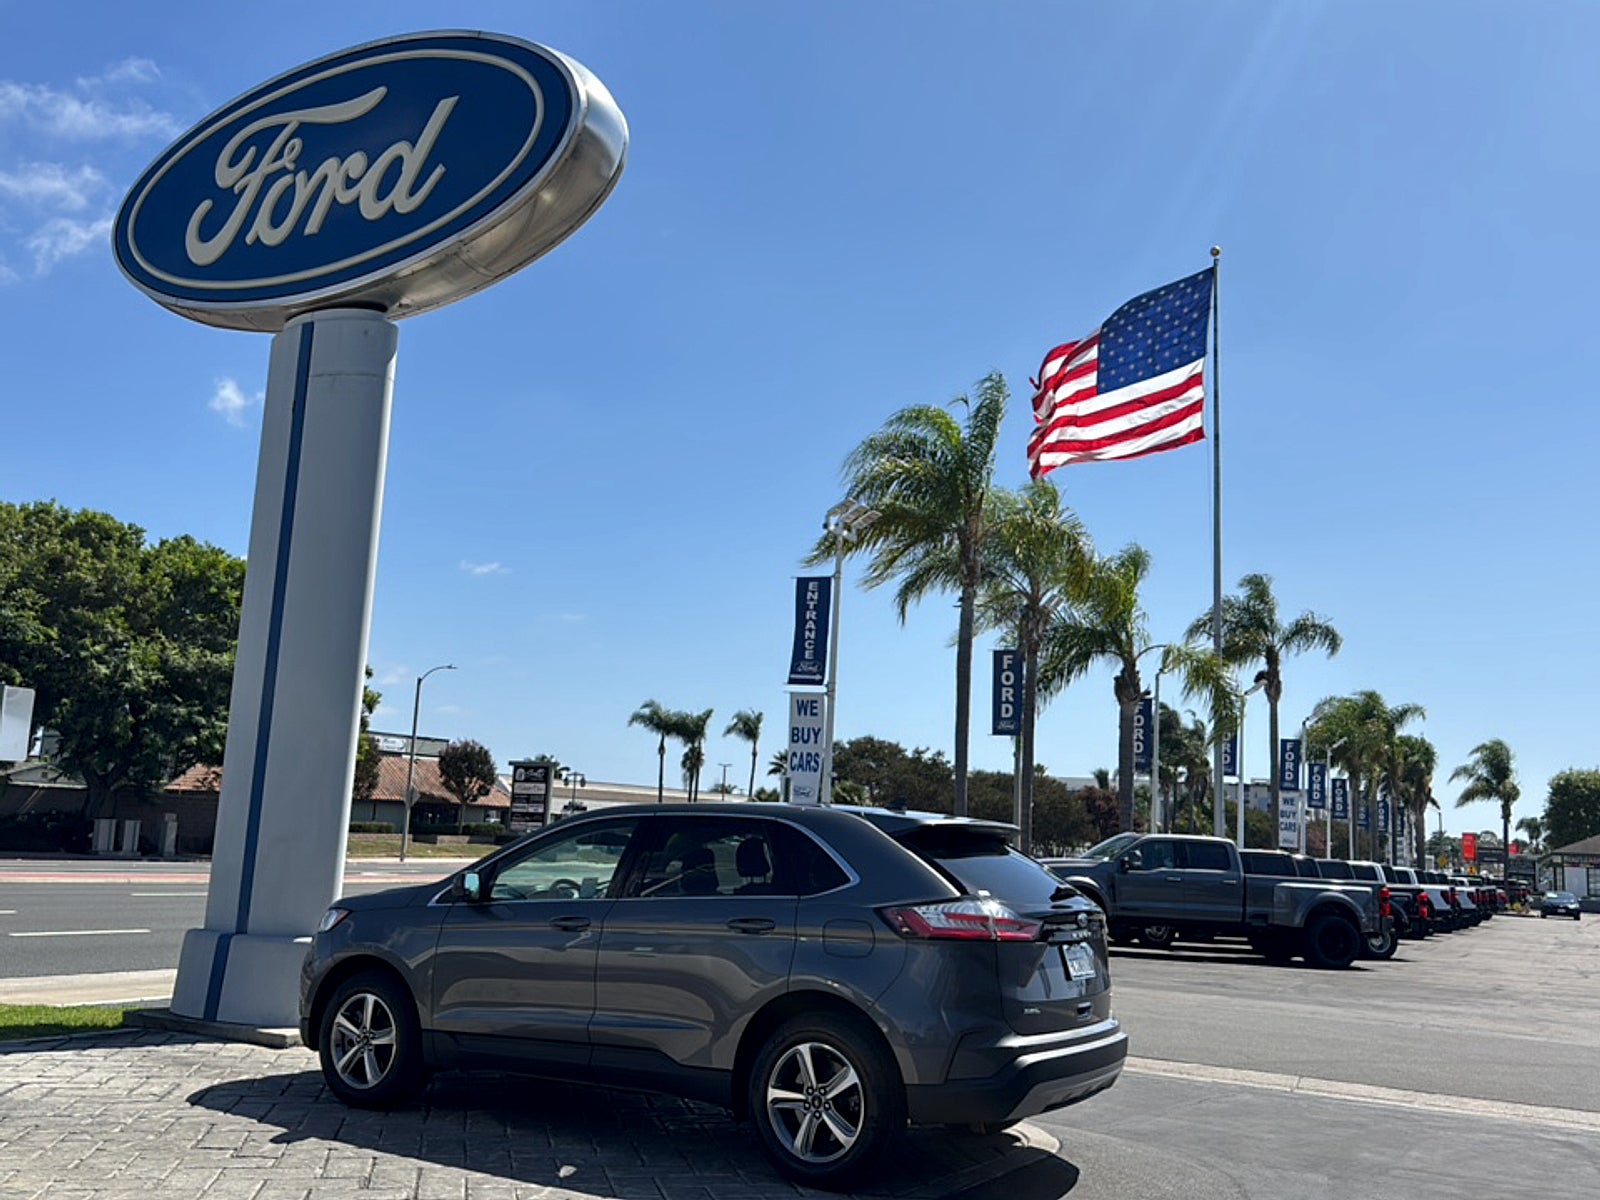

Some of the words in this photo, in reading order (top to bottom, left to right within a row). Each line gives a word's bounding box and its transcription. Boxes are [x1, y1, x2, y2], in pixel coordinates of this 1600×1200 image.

[185, 85, 459, 266] Ford
[804, 581, 819, 660] ENTRANCE
[1001, 654, 1015, 718] FORD
[796, 698, 818, 717] WE
[791, 726, 821, 745] BUY
[790, 751, 820, 773] CARS
[1284, 741, 1295, 781] FORD
[1312, 765, 1321, 800] FORD
[1335, 780, 1344, 812] FORD
[1281, 810, 1297, 820] BUY
[1282, 797, 1295, 806] WE
[1280, 821, 1296, 833] CARS
